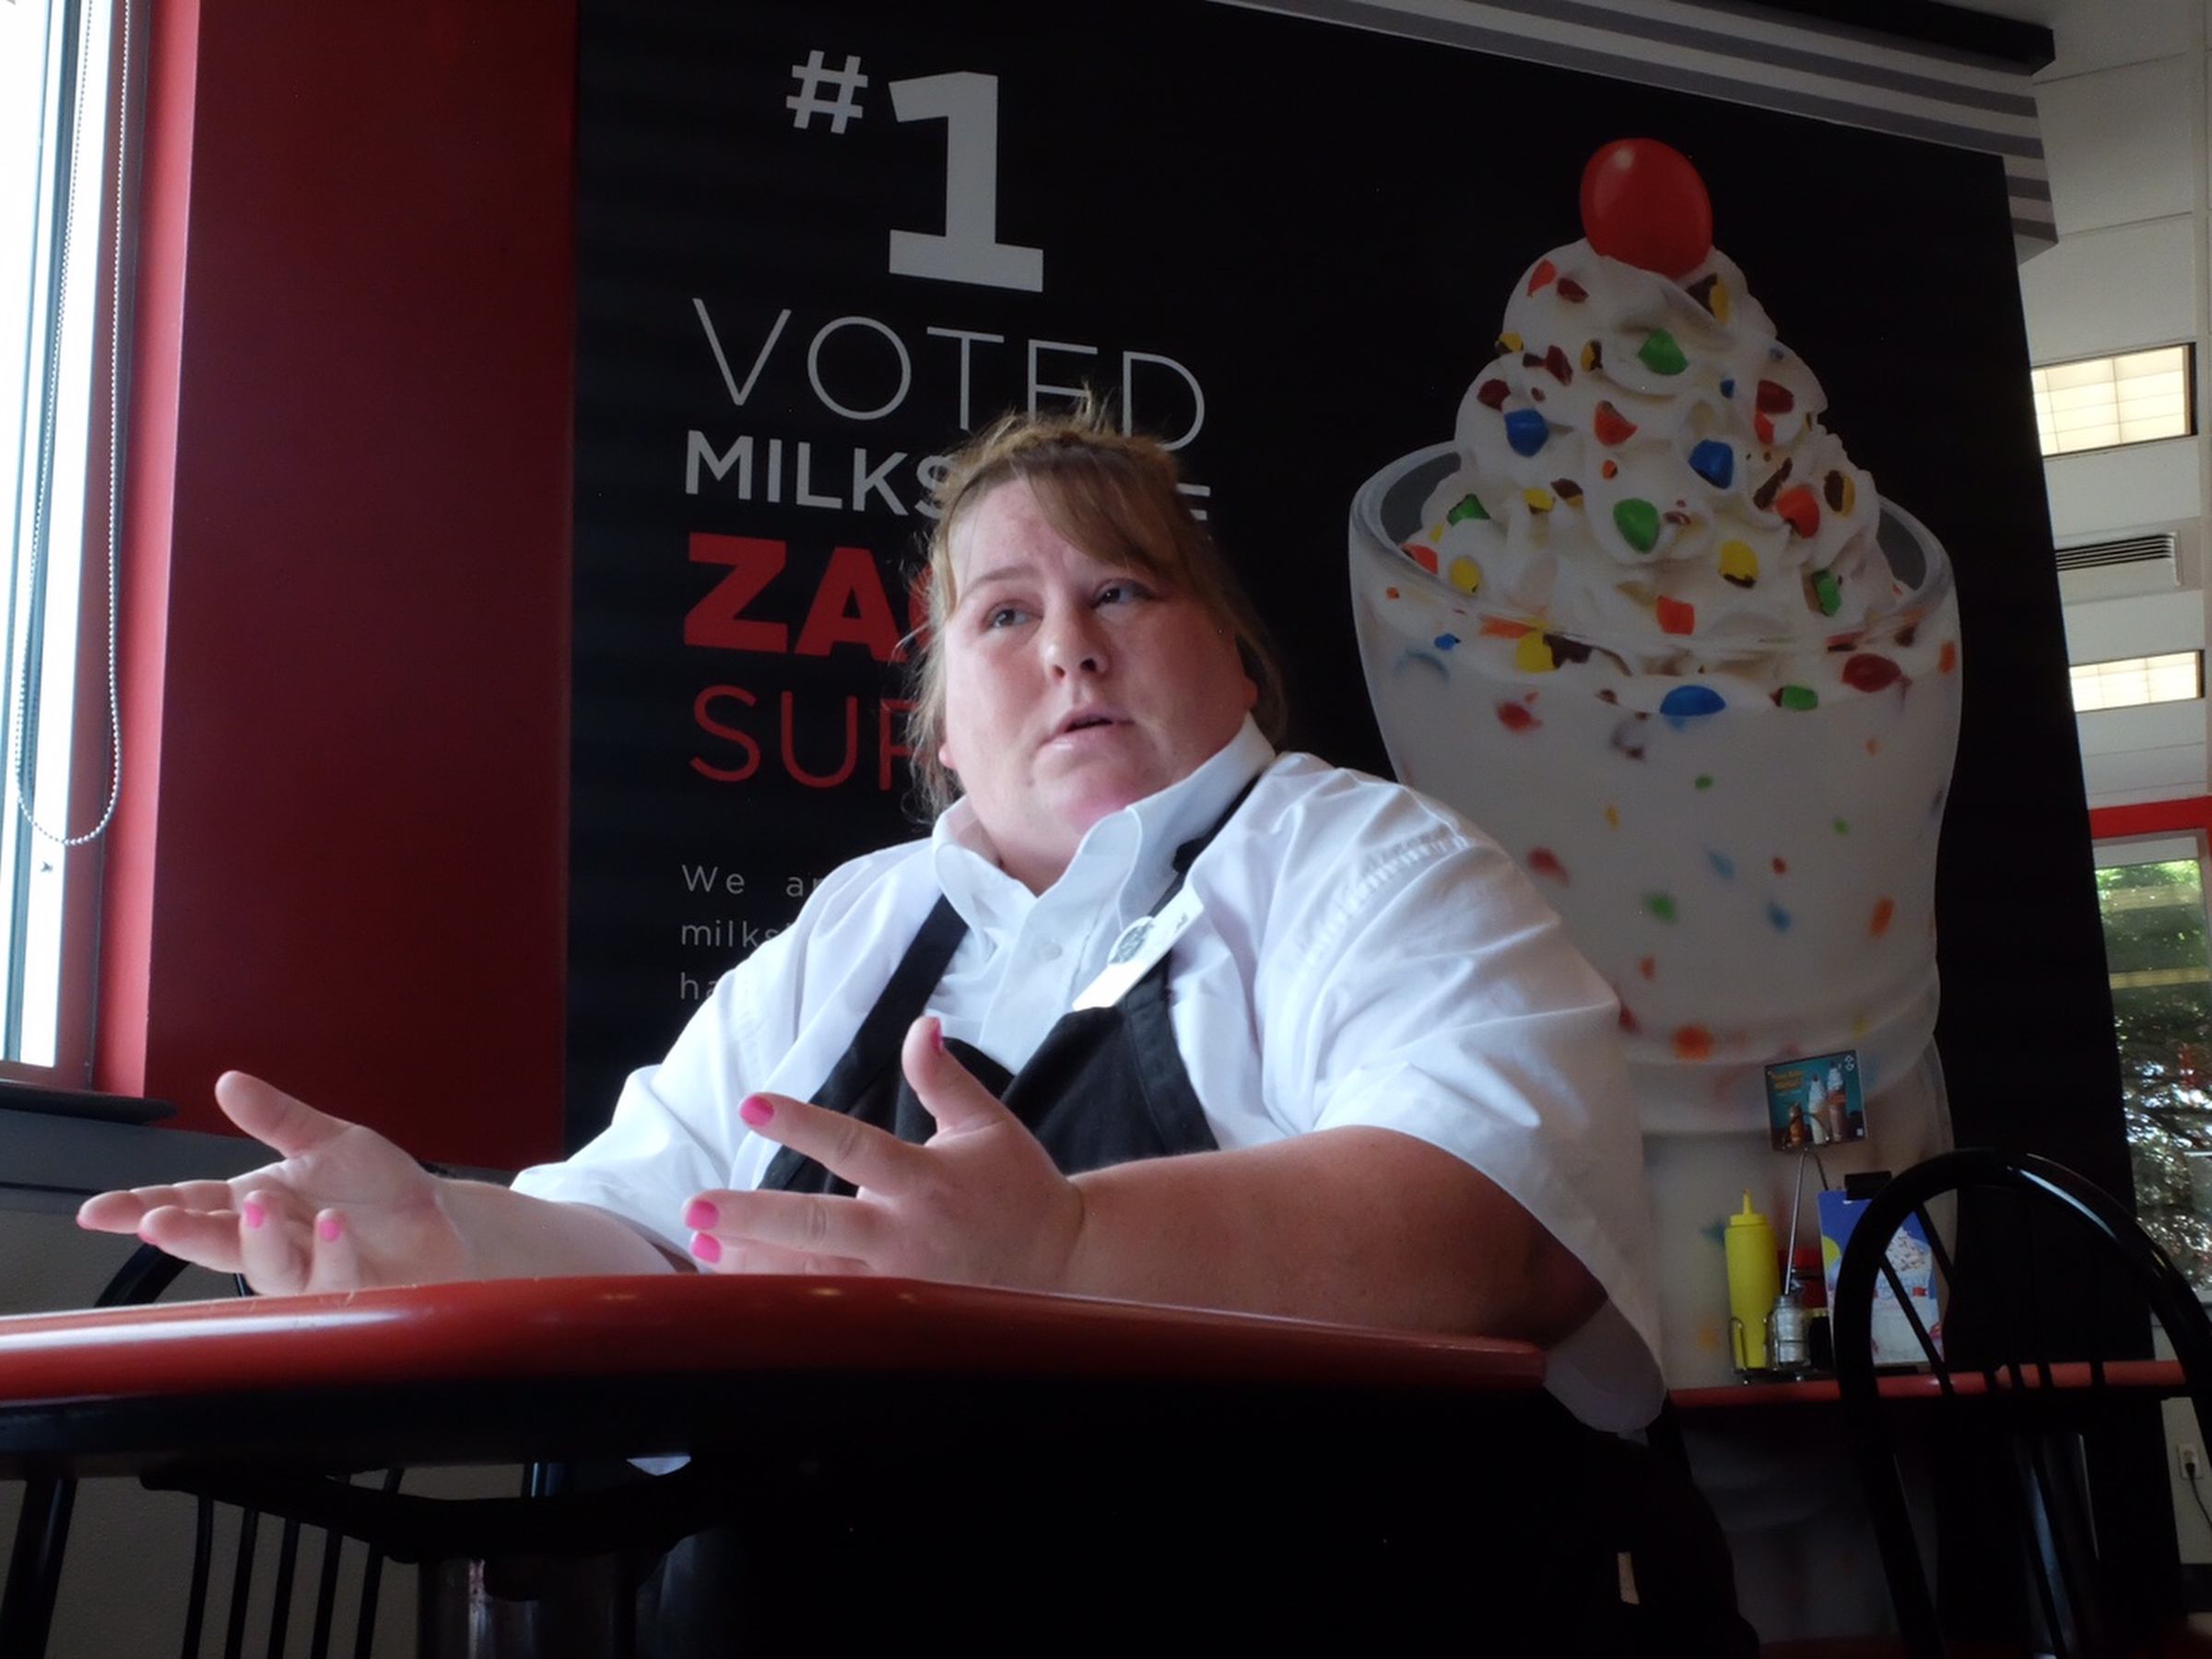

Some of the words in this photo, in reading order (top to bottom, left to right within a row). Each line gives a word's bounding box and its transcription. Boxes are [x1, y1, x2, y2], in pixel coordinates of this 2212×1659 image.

[786, 50, 1043, 292] #1
[692, 298, 1205, 452] VOTED
[684, 532, 933, 663] ZA
[681, 865, 746, 894] We
[681, 920, 794, 948] milks
